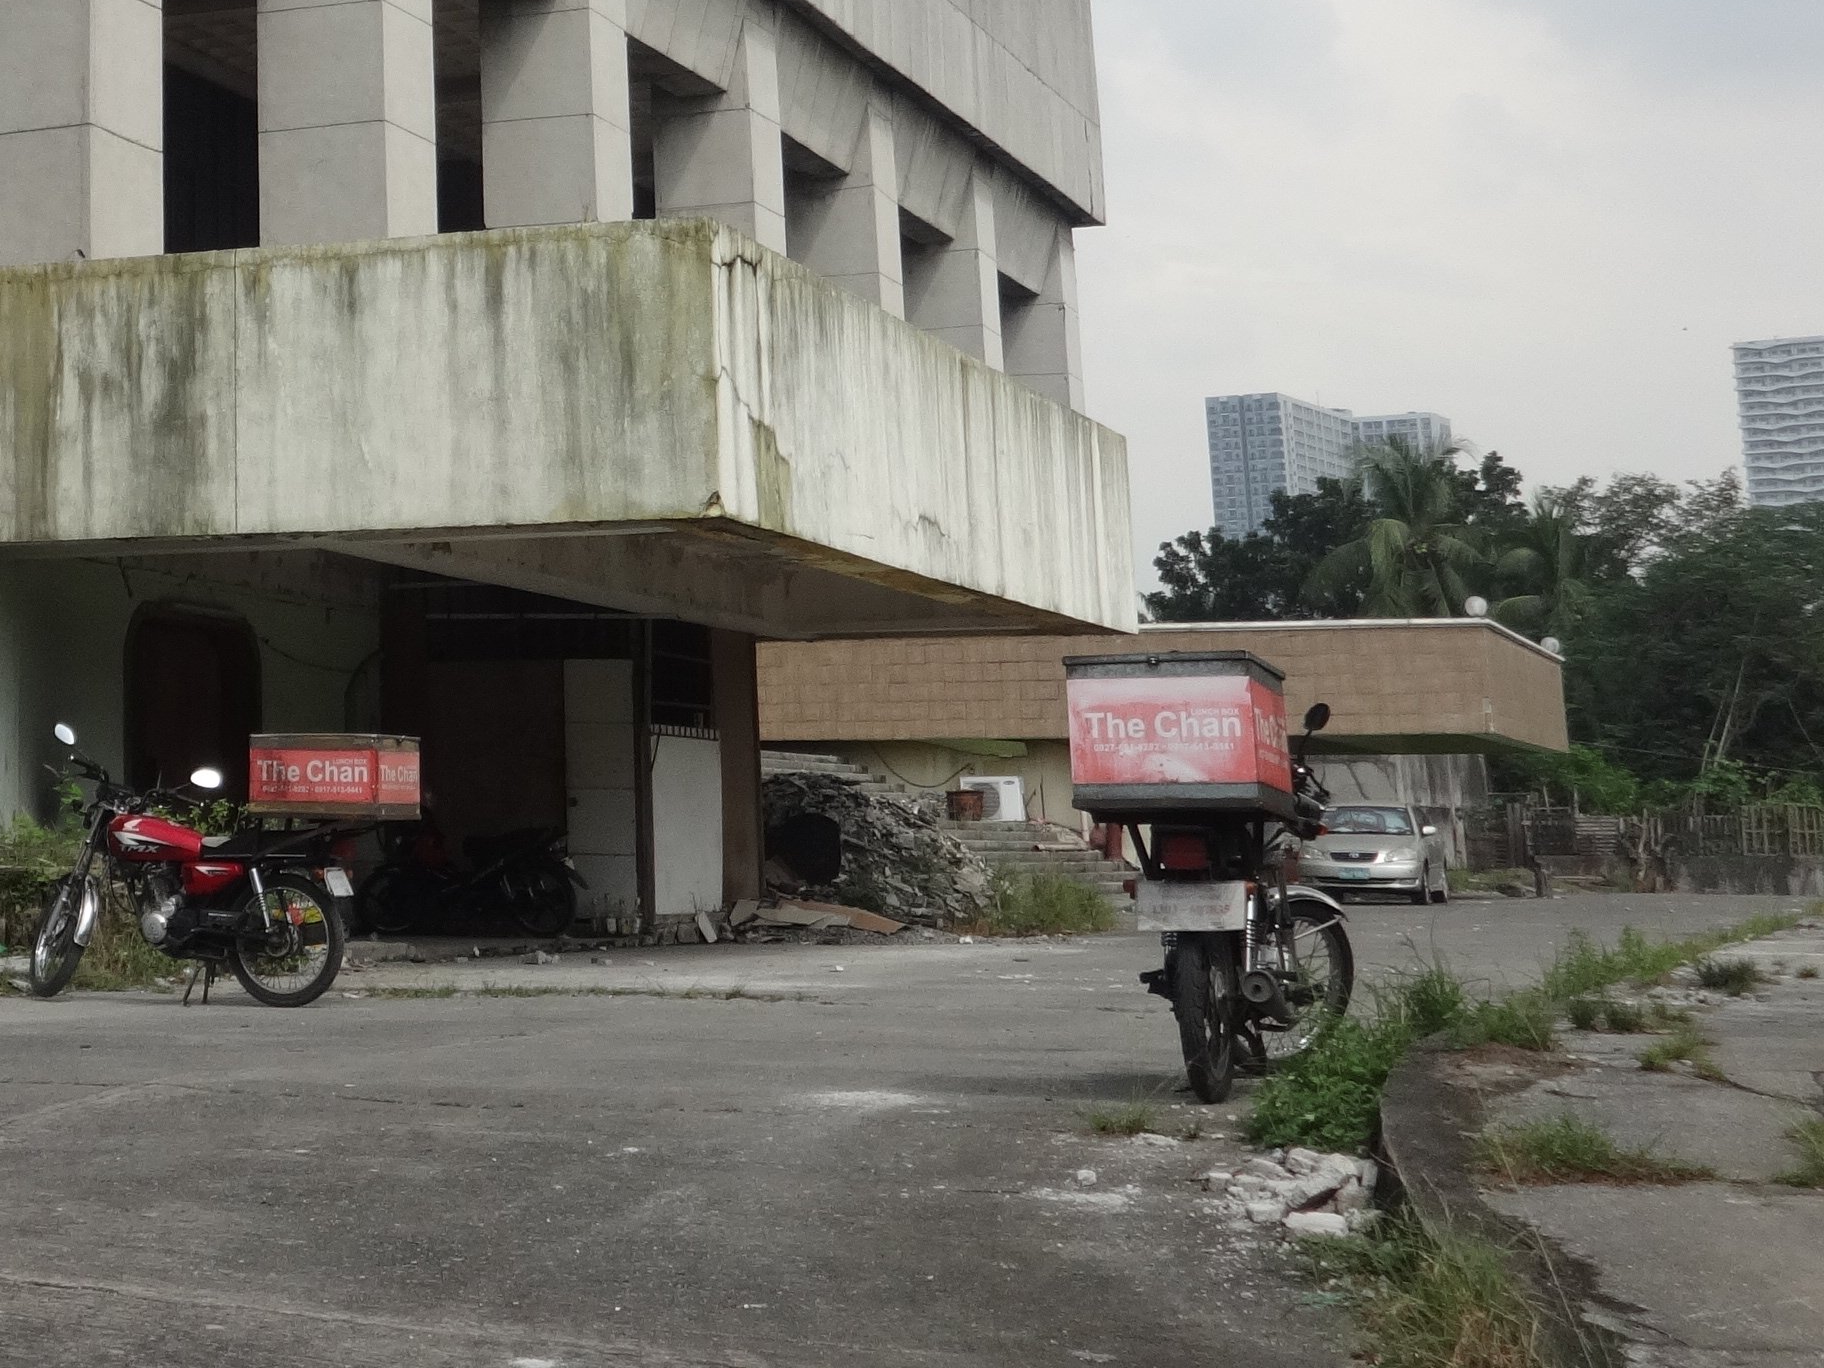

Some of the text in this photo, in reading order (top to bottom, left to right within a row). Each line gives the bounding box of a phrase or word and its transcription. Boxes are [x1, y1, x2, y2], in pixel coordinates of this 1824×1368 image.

[1190, 707, 1240, 716] LUNCH BOX
[1083, 712, 1146, 739] The
[1154, 711, 1242, 739] Chan
[257, 759, 368, 783] The Chan
